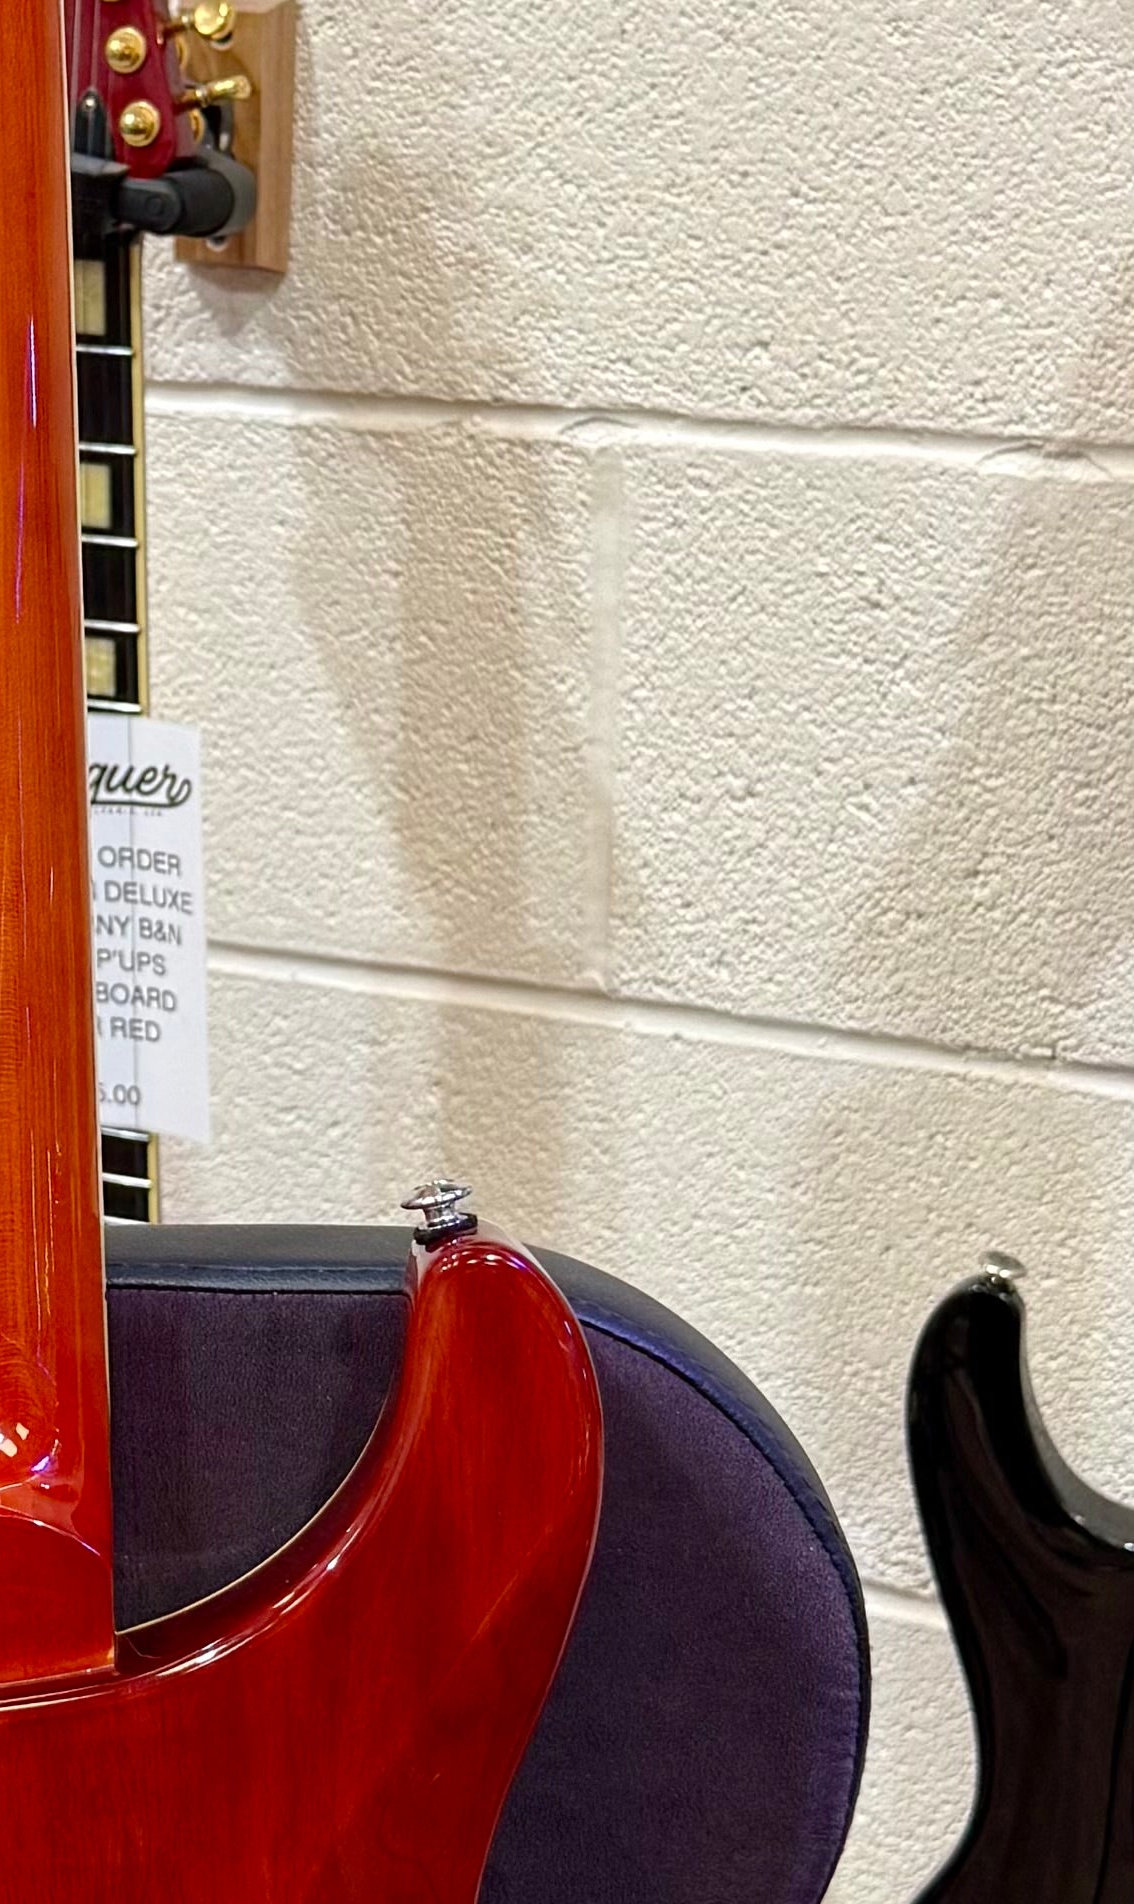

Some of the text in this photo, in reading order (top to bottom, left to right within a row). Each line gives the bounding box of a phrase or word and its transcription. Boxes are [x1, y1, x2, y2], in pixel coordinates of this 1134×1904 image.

[97, 845, 181, 877] ORDER
[104, 879, 194, 916] DELUXE
[139, 917, 183, 946] B&N
[96, 948, 167, 977] P'UPS
[110, 1016, 161, 1043] RED
